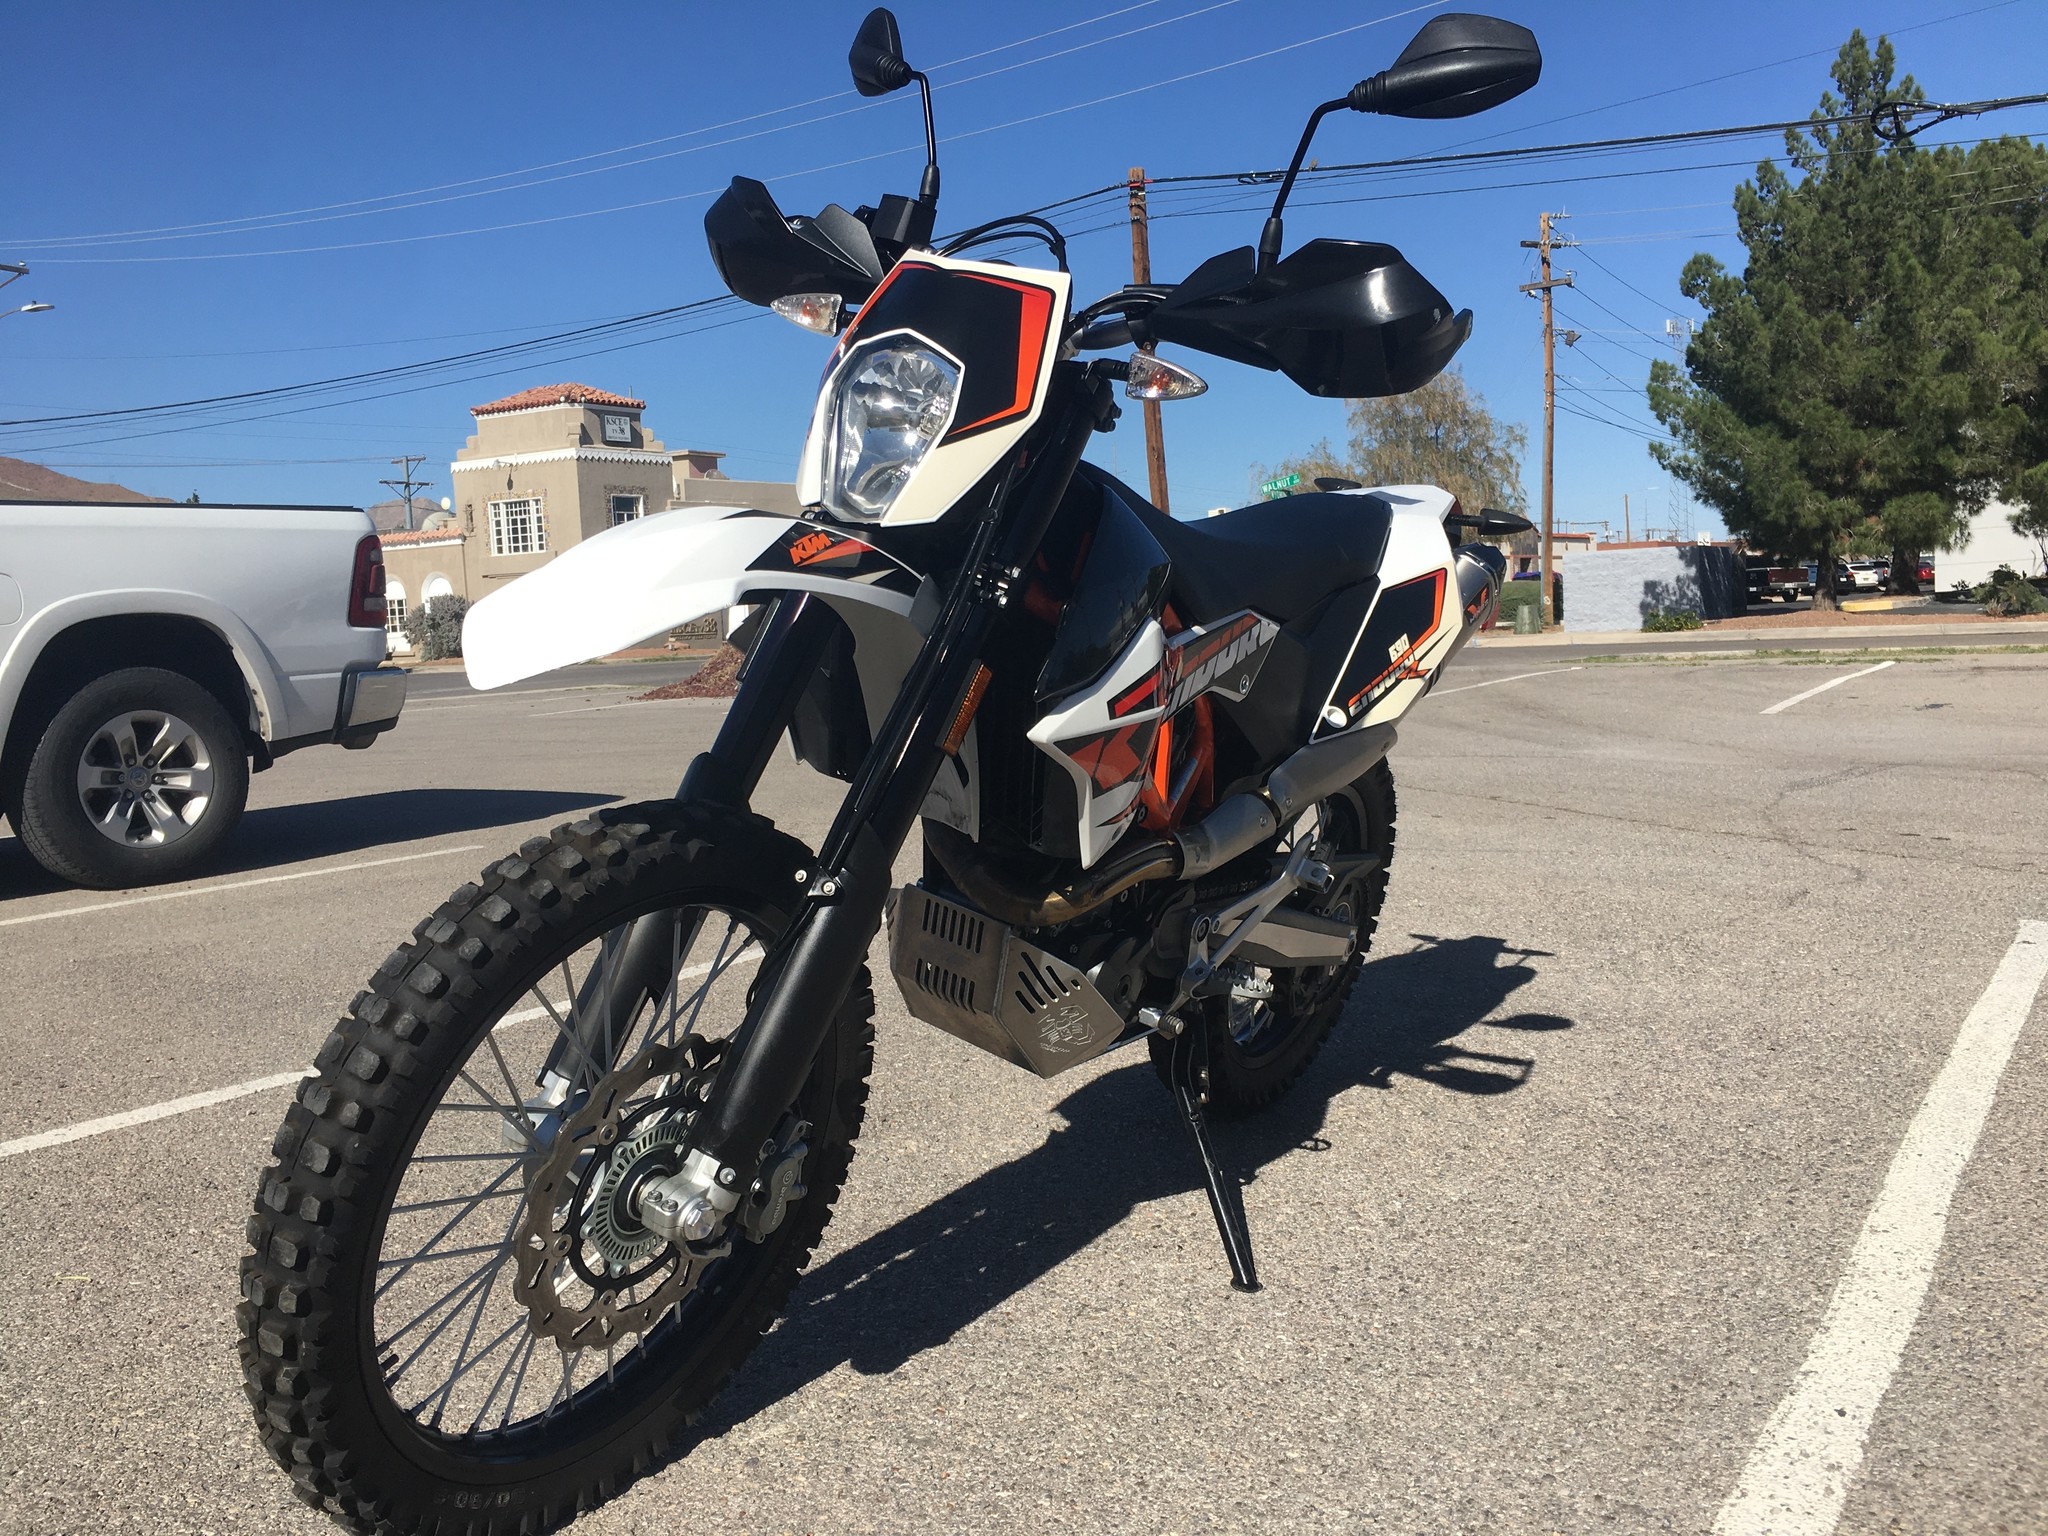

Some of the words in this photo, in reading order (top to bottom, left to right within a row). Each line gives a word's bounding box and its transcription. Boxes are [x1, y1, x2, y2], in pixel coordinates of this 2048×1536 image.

[1262, 477, 1290, 493] WALNUT
[789, 532, 832, 565] KTM
[703, 617, 717, 633] 38
[1388, 633, 1410, 664] 690
